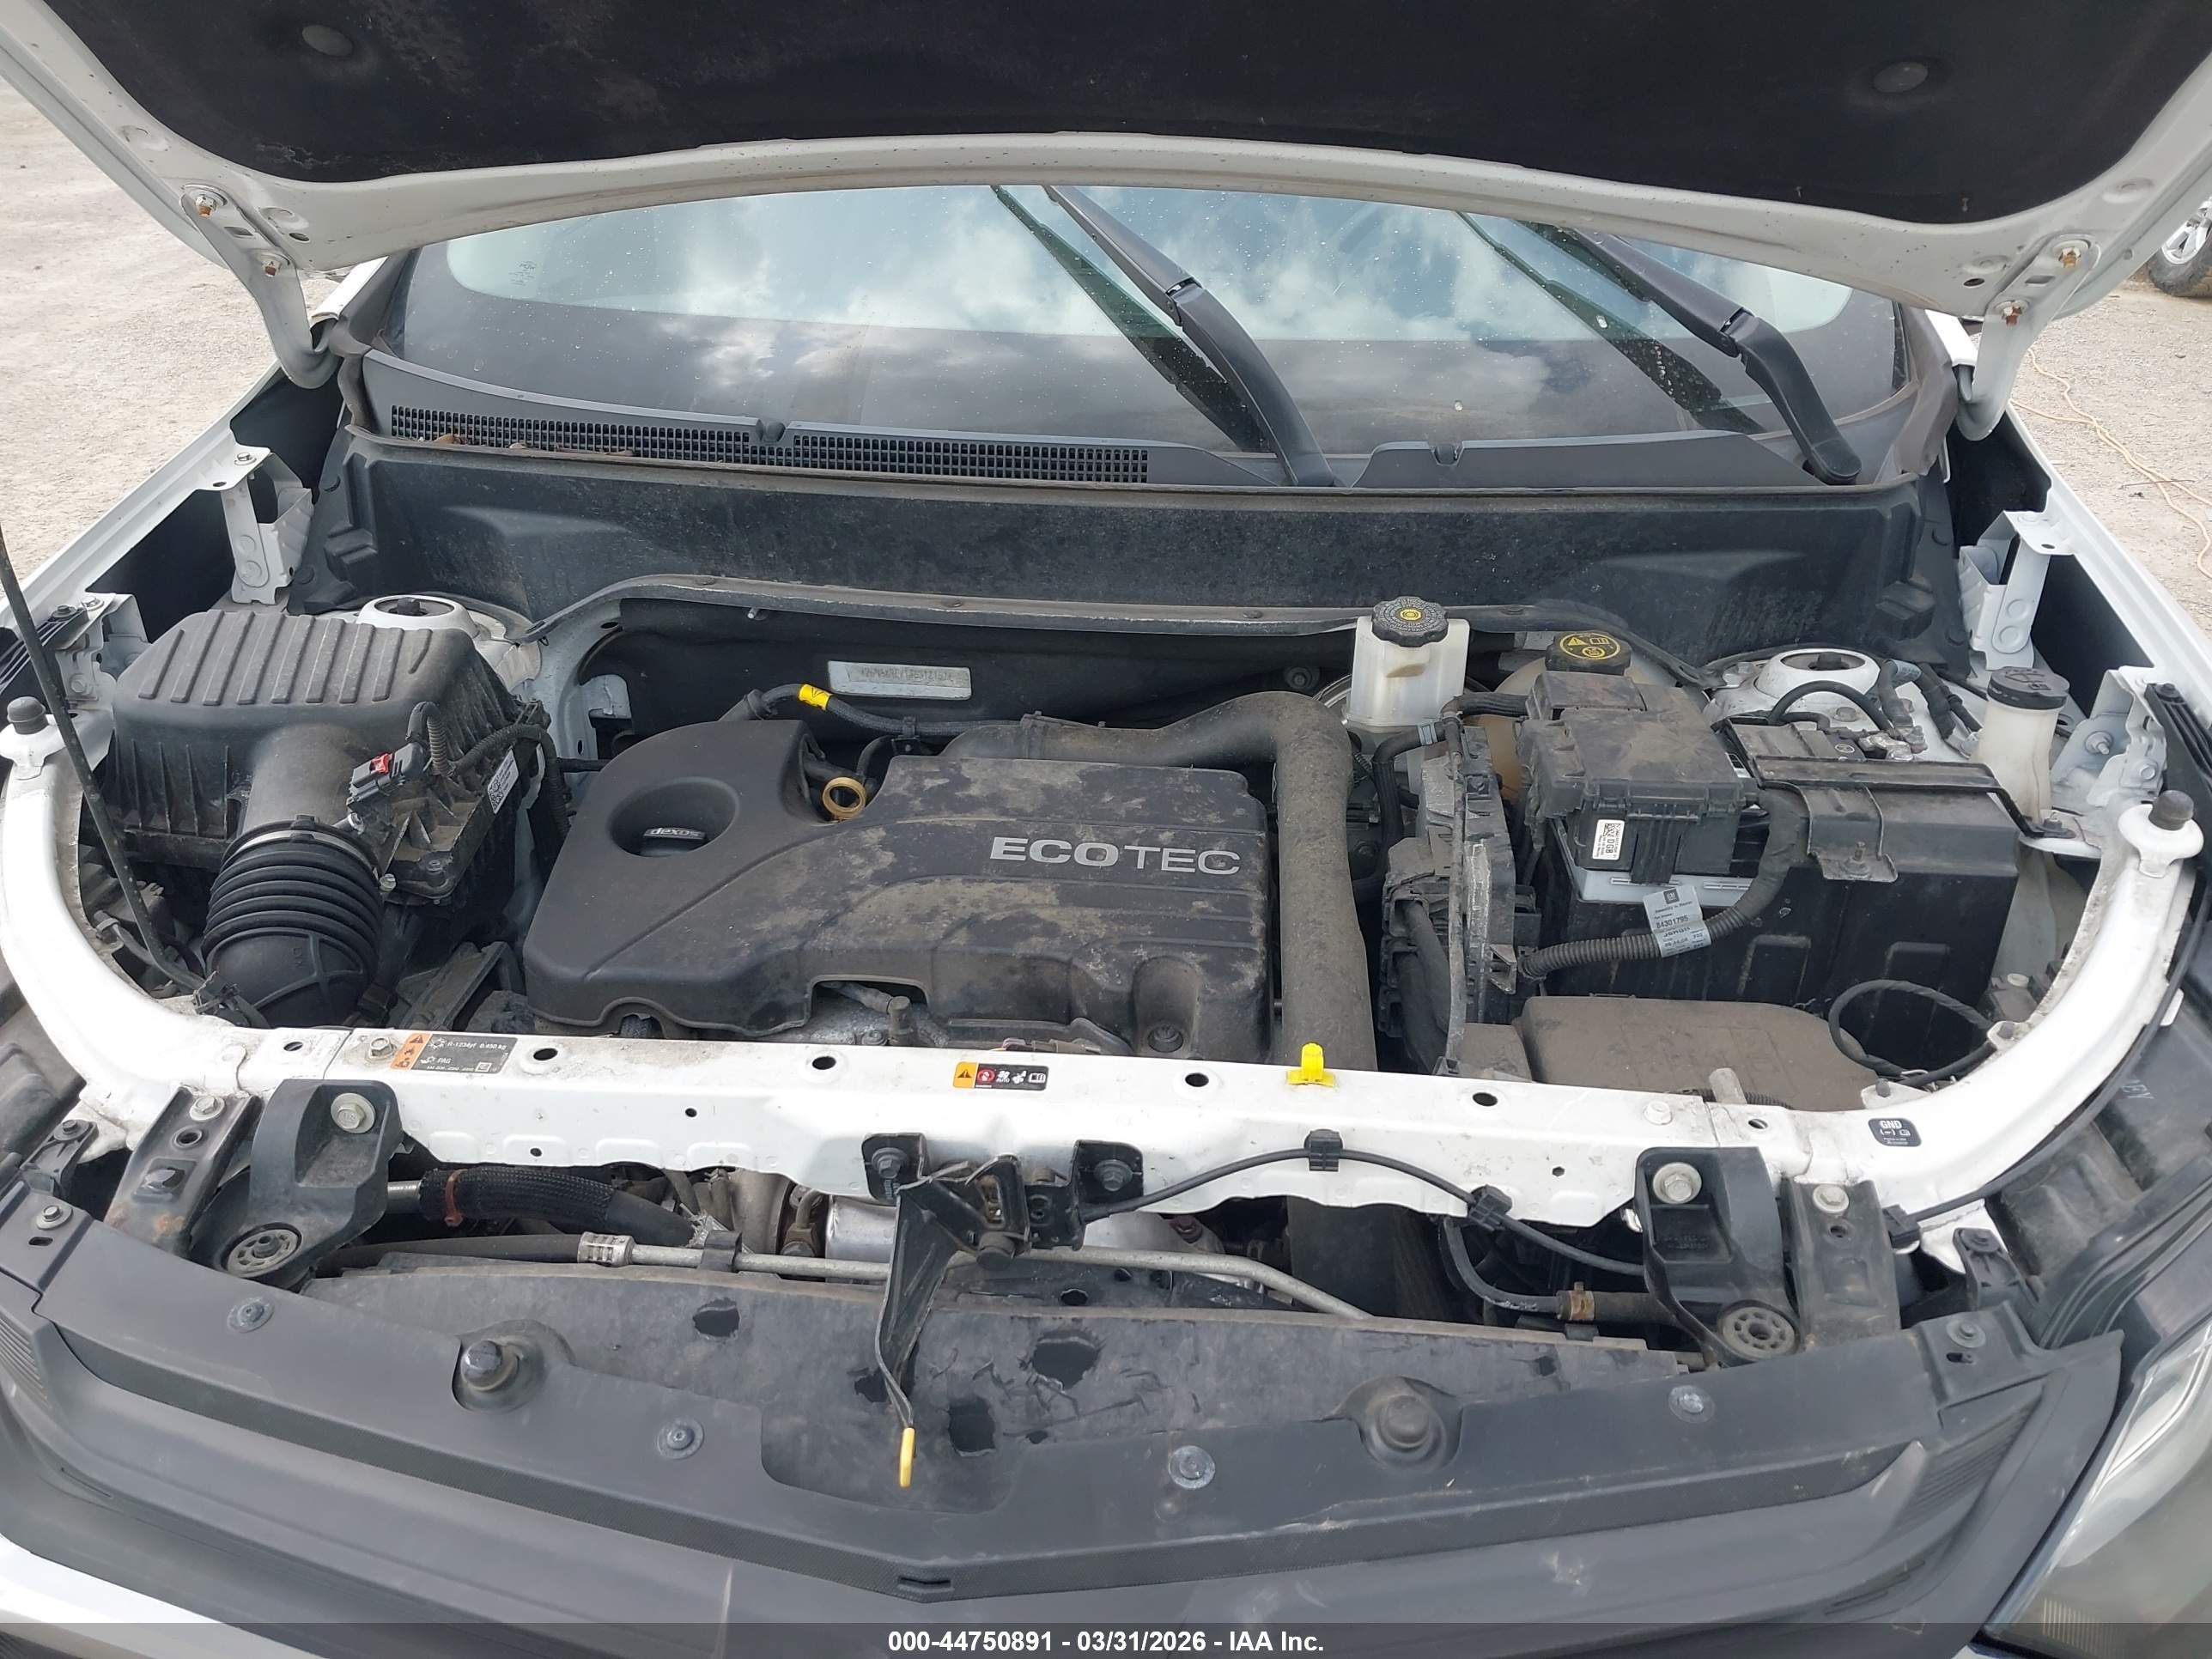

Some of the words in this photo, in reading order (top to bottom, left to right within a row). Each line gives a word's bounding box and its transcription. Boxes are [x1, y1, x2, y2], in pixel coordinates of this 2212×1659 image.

[650, 827, 701, 837] dexos
[989, 836, 1241, 875] ECOTEC
[1880, 1120, 1902, 1129] GND
